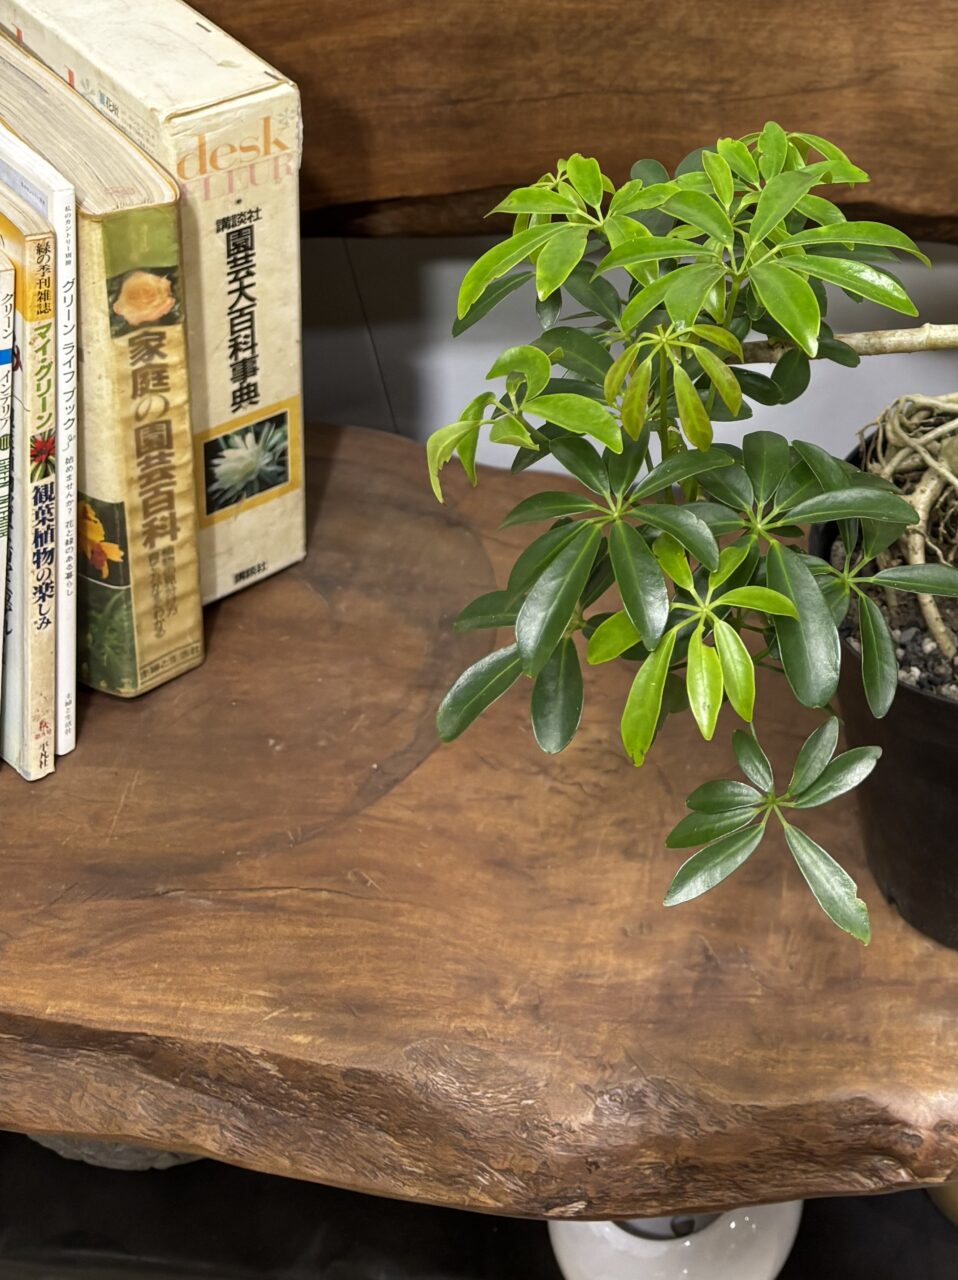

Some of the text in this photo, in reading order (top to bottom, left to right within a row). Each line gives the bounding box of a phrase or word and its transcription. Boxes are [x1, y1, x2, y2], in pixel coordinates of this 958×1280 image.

[177, 116, 289, 181] desk
[216, 208, 263, 233] 講談社
[1, 293, 13, 339] グリーン
[36, 241, 51, 315] 緑の季刊雑誌
[226, 225, 260, 413] 園芸大百科事典
[34, 322, 52, 430] マイ・グリーン
[62, 278, 76, 430] グリーン ライフ ブック
[128, 331, 181, 548] 家庭の園芸百科
[32, 481, 55, 630] 観葉植物の楽しみ
